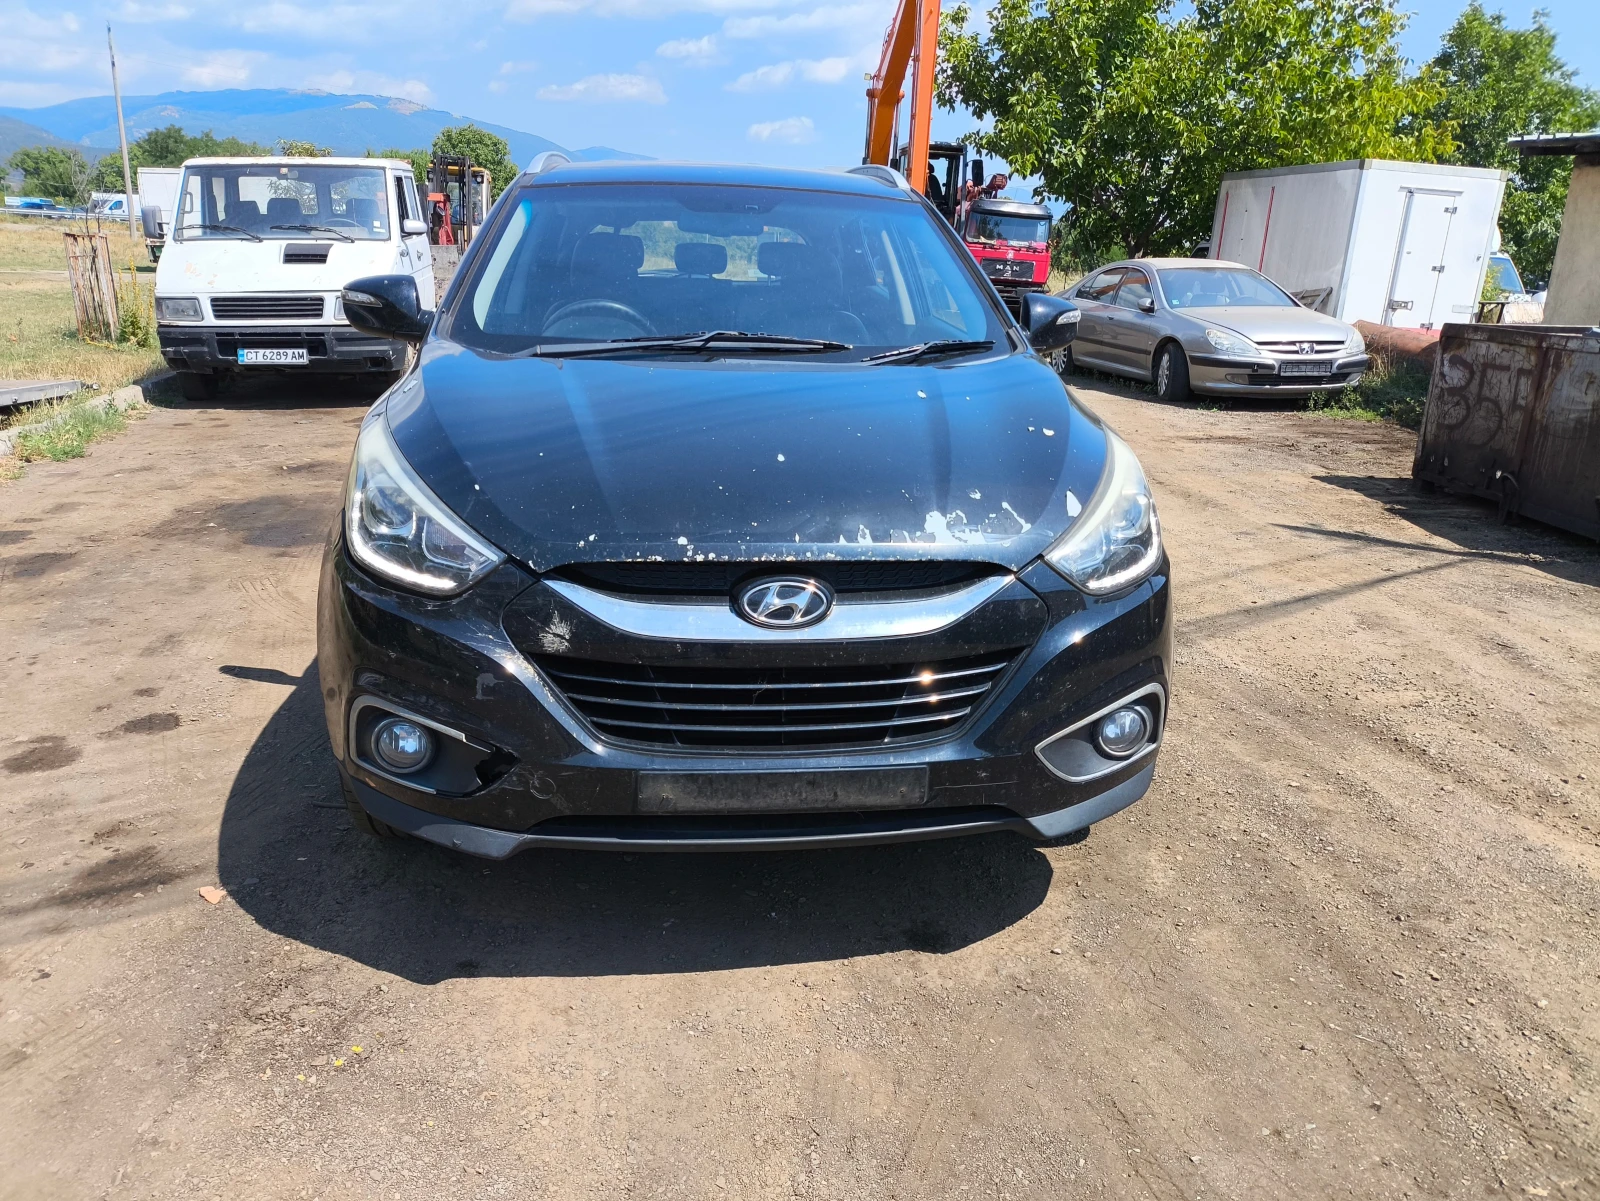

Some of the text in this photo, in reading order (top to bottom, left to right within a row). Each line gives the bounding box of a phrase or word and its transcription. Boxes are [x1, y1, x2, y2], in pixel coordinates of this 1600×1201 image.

[995, 264, 1020, 272] MAN
[246, 351, 305, 361] CT 6289 AM
